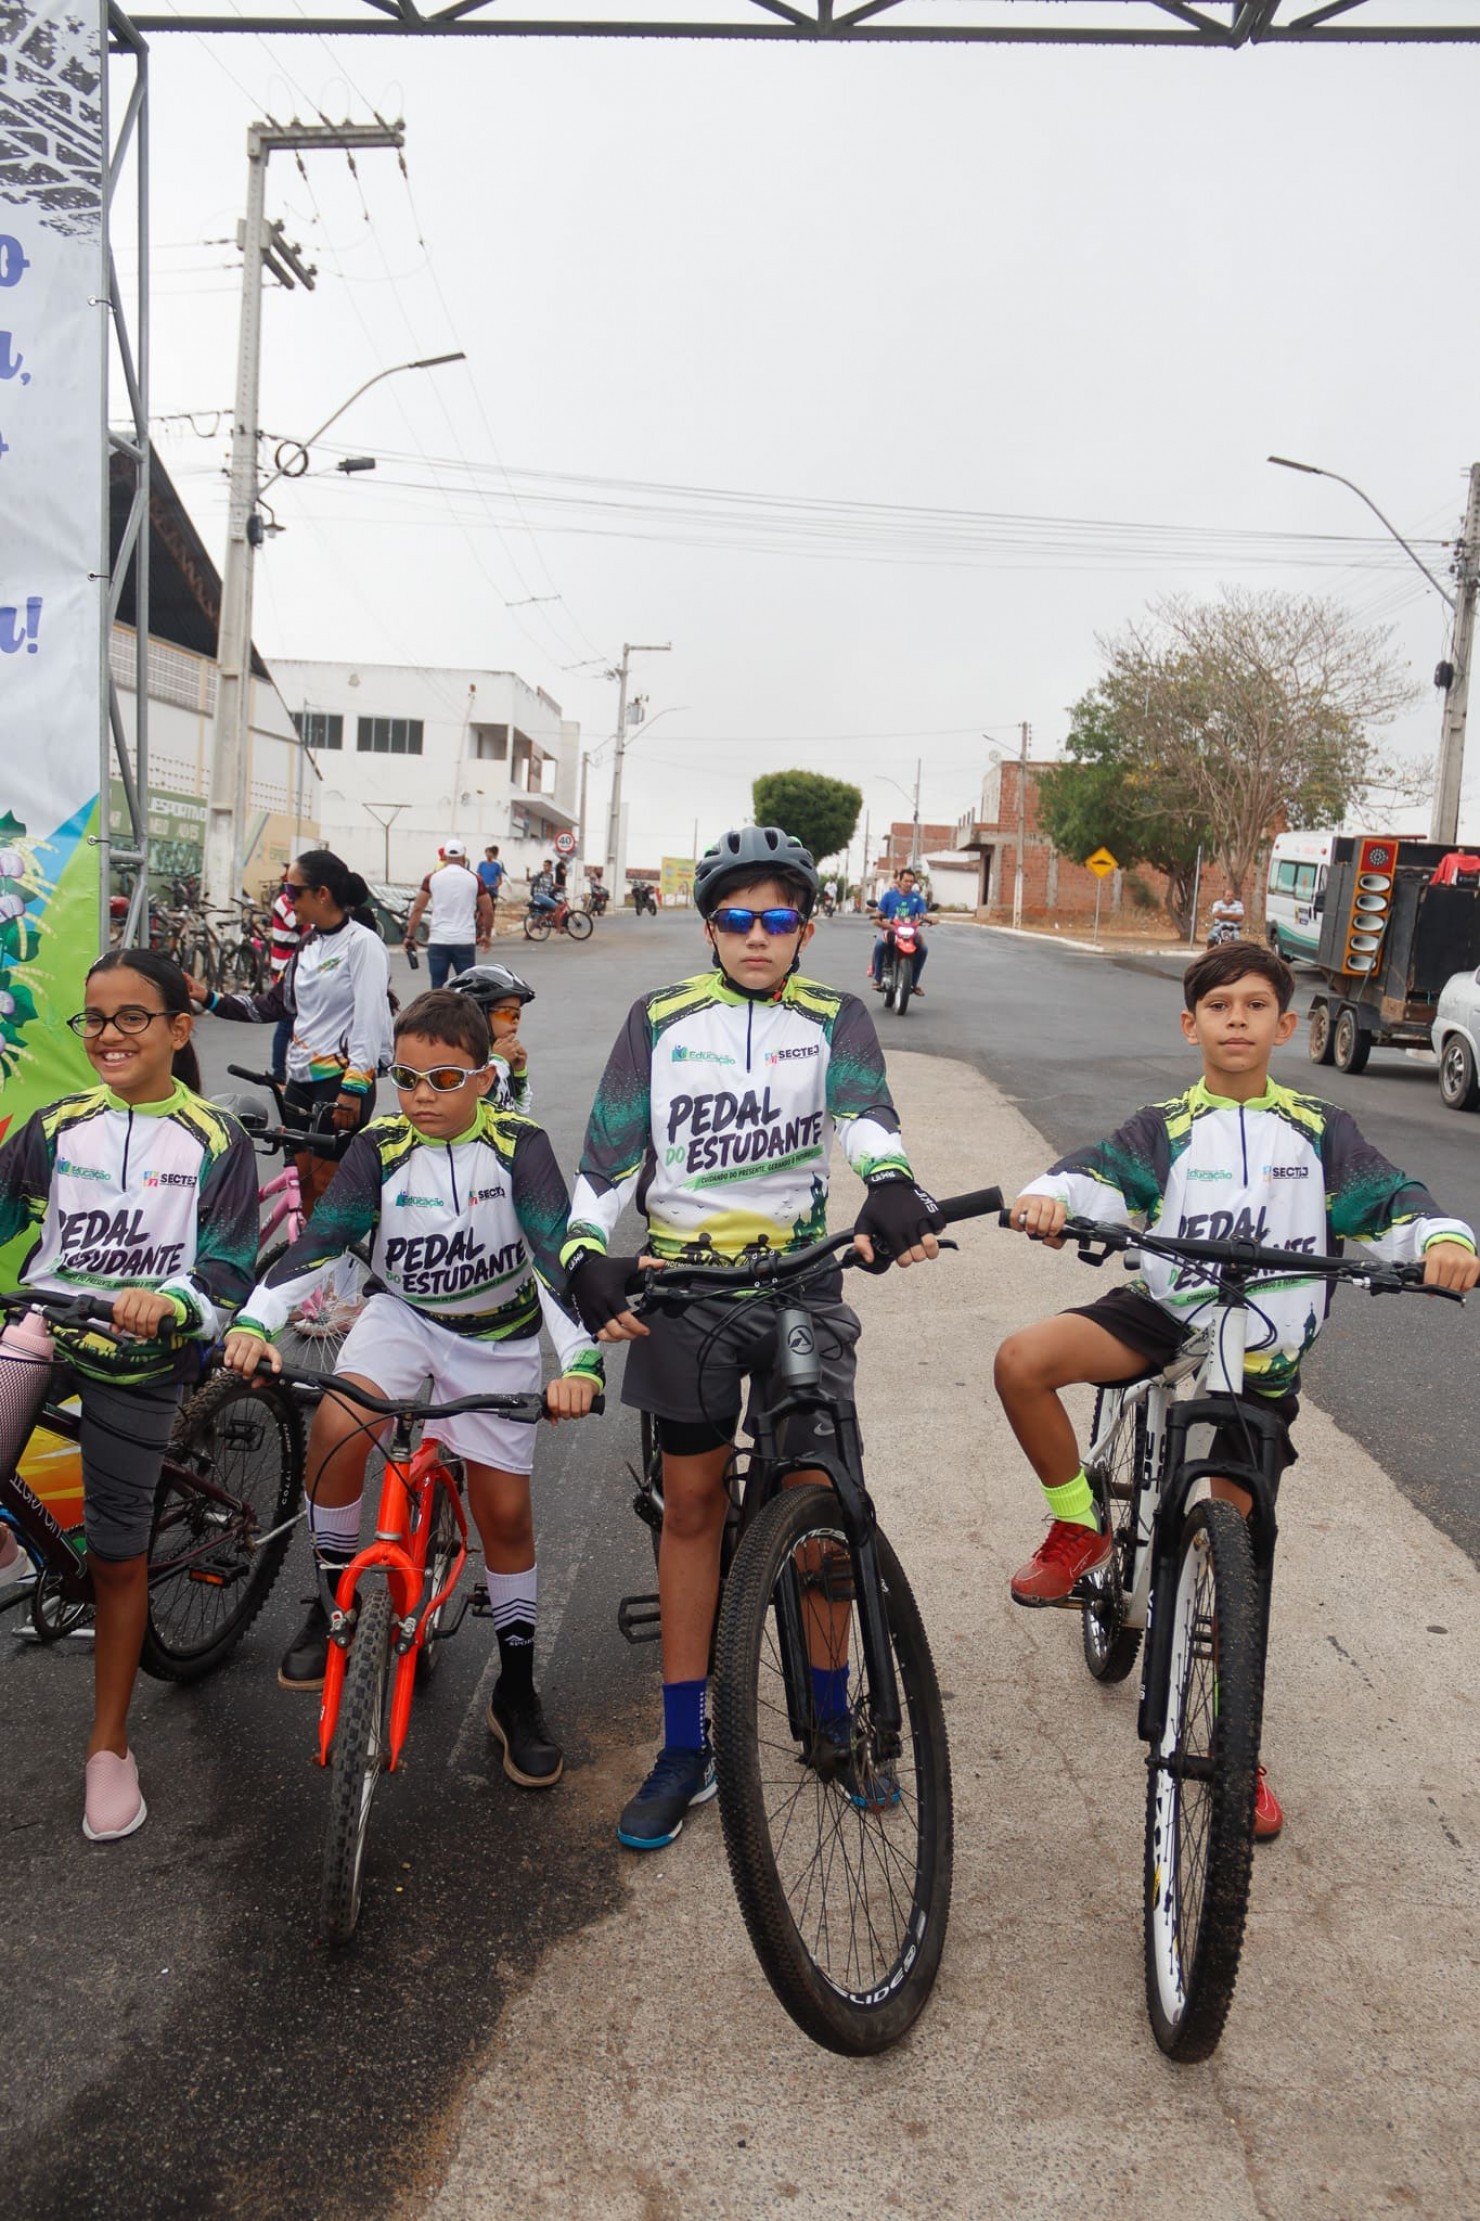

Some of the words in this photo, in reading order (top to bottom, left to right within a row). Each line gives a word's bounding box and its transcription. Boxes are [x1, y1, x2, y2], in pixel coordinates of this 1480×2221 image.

[558, 835, 572, 845] 40
[665, 1146, 686, 1167] DO
[686, 1111, 824, 1174] ESTUDANTE
[667, 1086, 783, 1145] PEDAL
[385, 1226, 487, 1273] PEDAL
[385, 1271, 400, 1284] DO
[402, 1239, 526, 1295] ESTUDANTE
